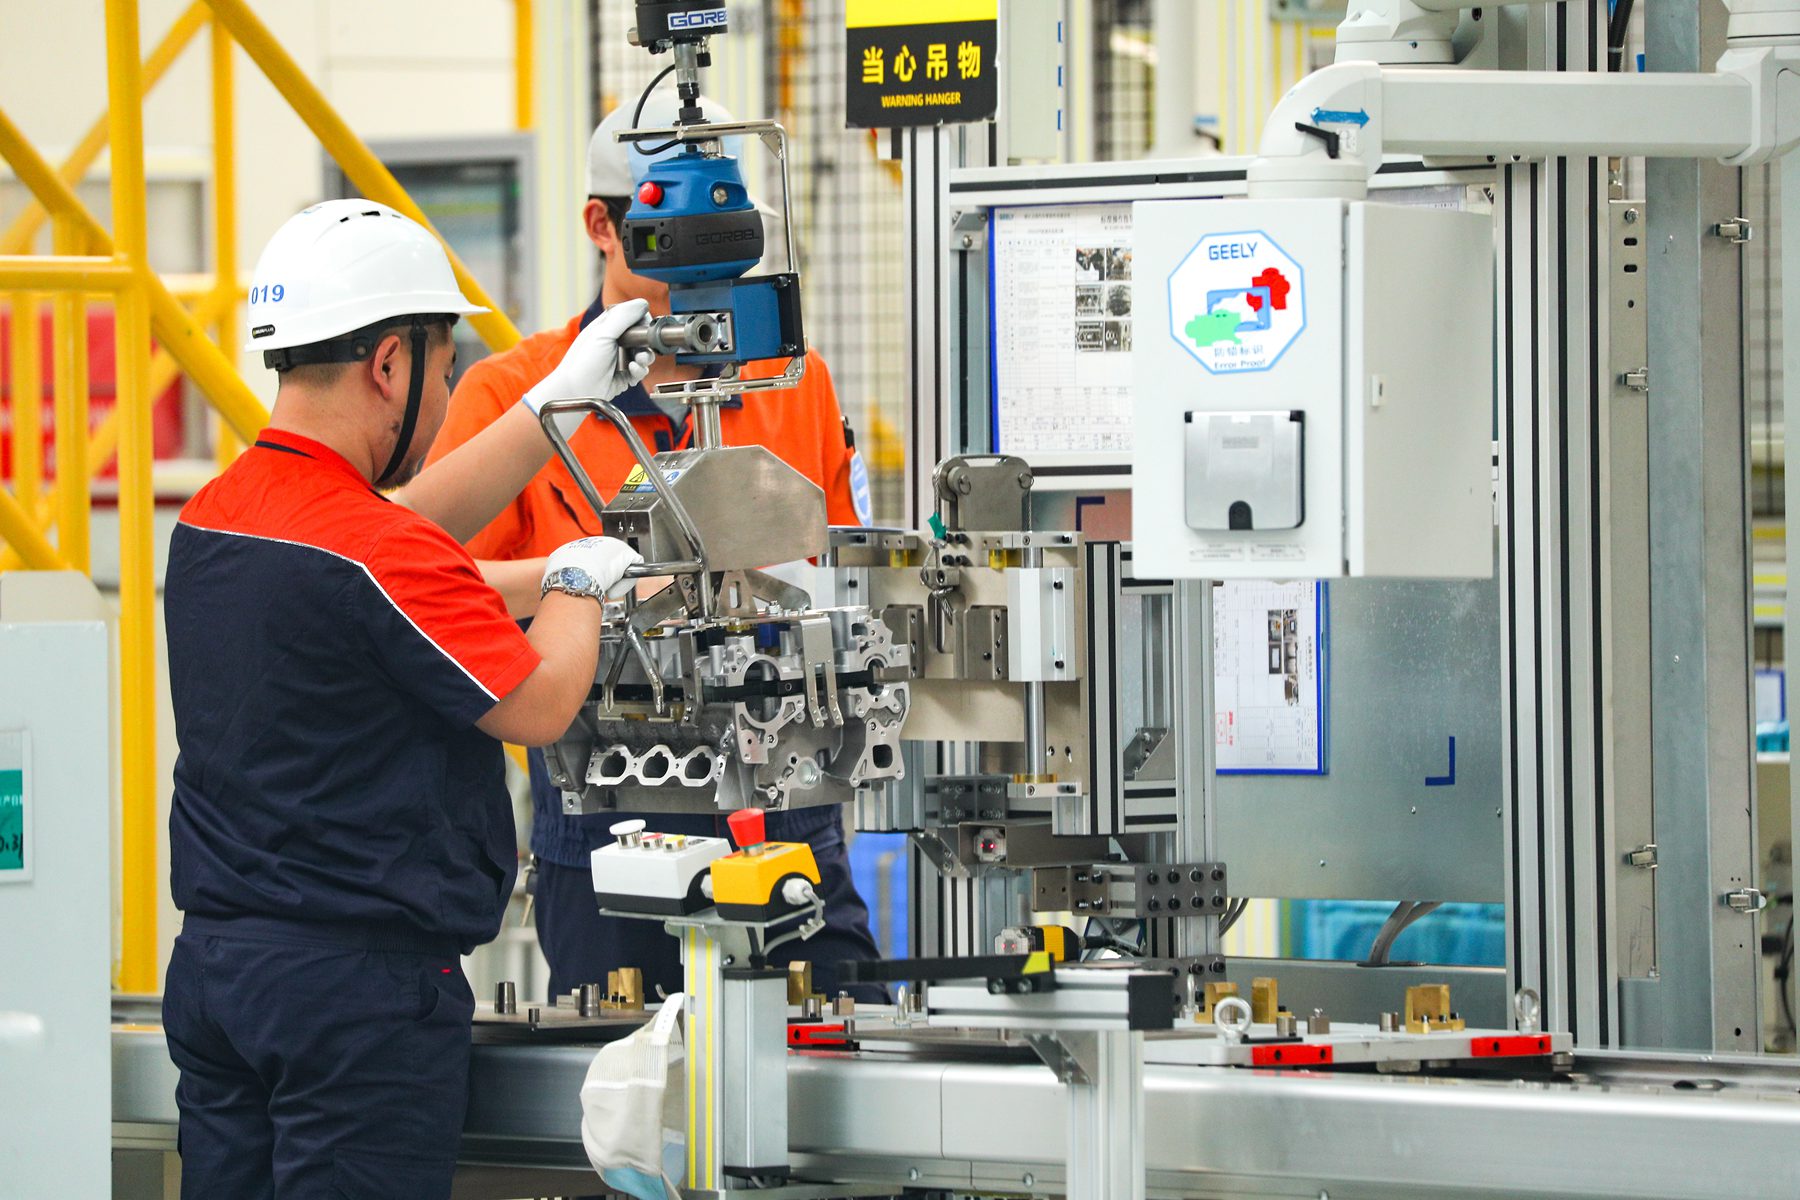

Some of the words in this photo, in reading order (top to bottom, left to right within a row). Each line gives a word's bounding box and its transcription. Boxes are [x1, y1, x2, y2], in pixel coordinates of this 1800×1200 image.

[862, 41, 981, 84] 当心吊物
[881, 93, 923, 108] WARNING
[925, 91, 961, 105] HANGER
[696, 229, 760, 245] GORBEL
[1208, 241, 1258, 261] GEELY
[251, 284, 285, 305] 019
[1240, 358, 1266, 368] Proof
